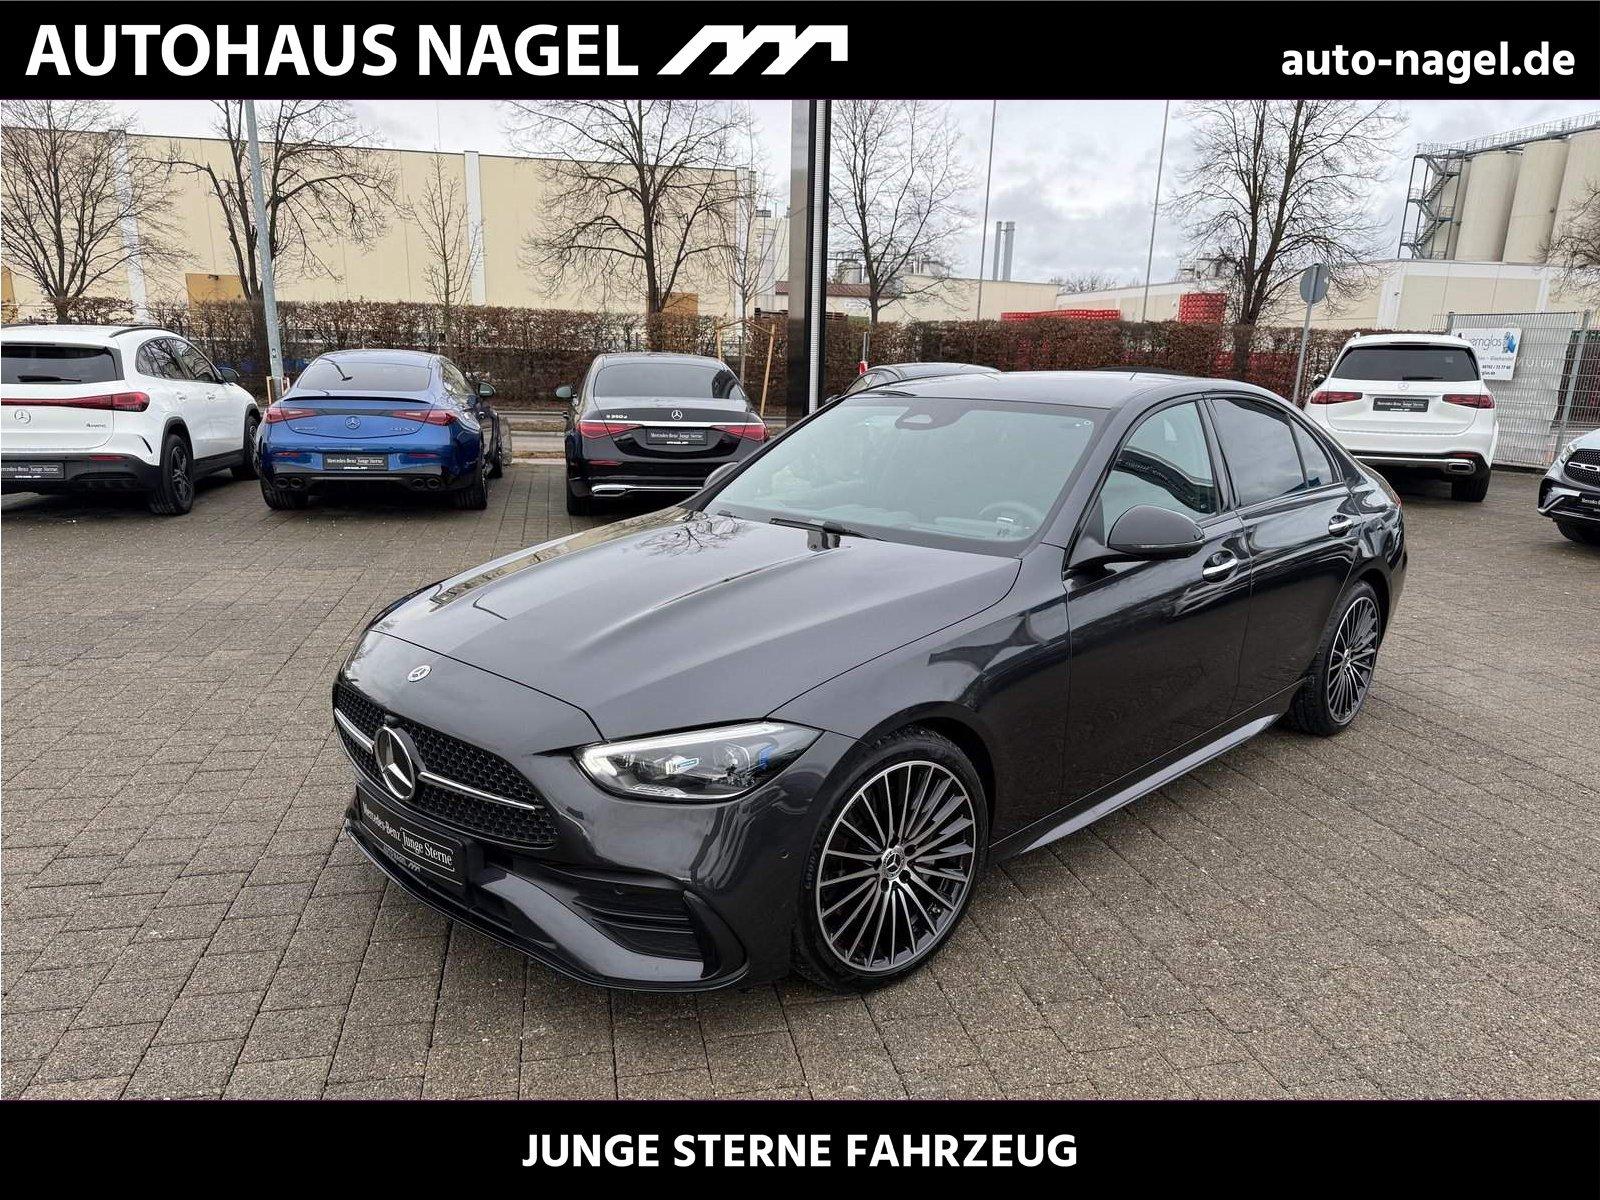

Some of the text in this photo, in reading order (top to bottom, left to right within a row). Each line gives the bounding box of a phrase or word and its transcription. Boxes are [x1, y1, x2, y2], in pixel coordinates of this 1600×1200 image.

[363, 801, 402, 842] Mercedes-Benz
[402, 831, 424, 855] Junge
[424, 842, 453, 867] Sterne
